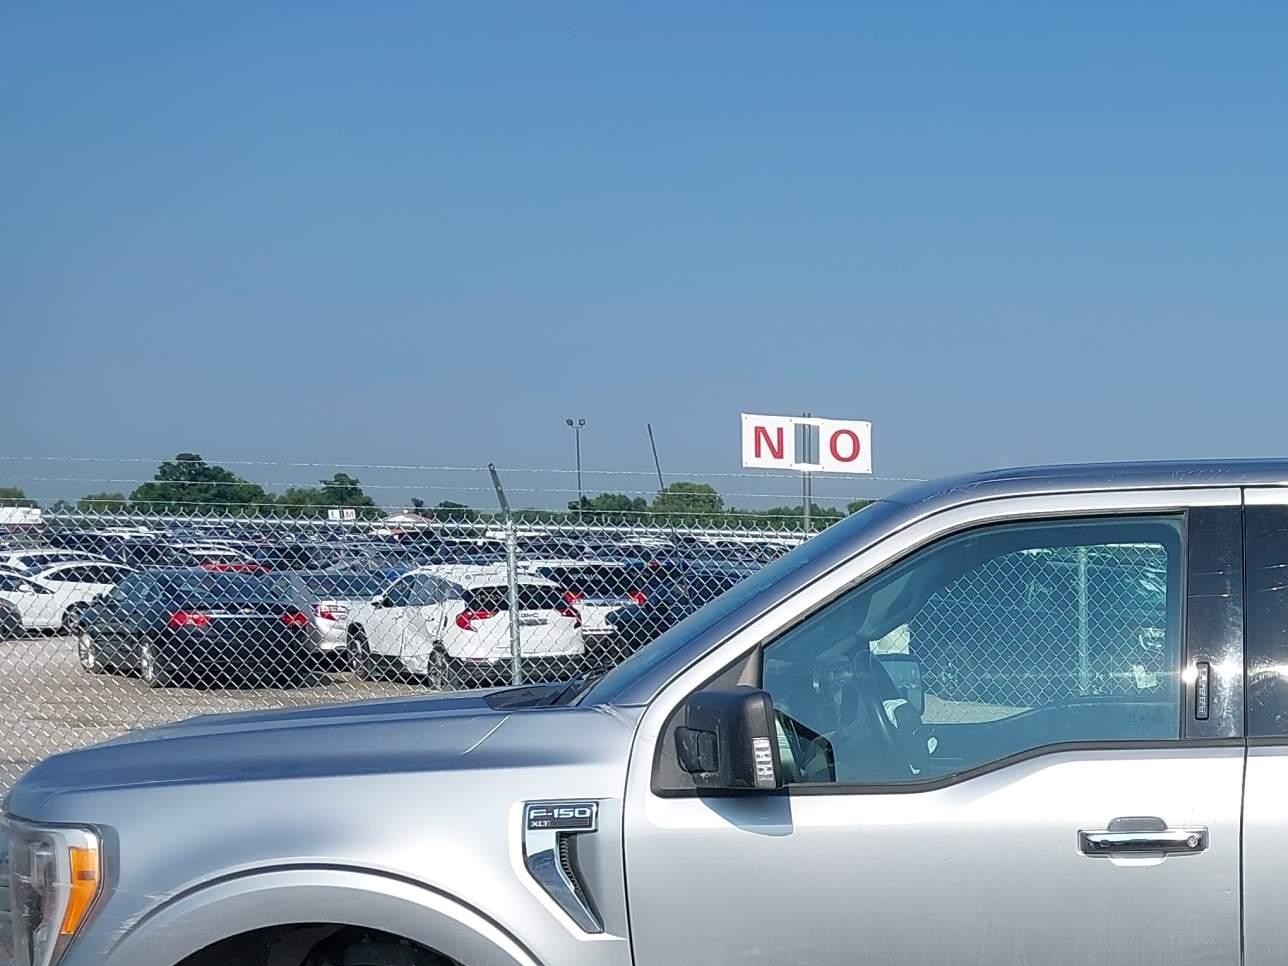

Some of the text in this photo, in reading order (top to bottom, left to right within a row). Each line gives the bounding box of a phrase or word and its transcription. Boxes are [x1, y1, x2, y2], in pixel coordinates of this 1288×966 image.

[753, 426, 861, 462] N O
[529, 807, 592, 819] F-150
[530, 820, 549, 828] XLT
